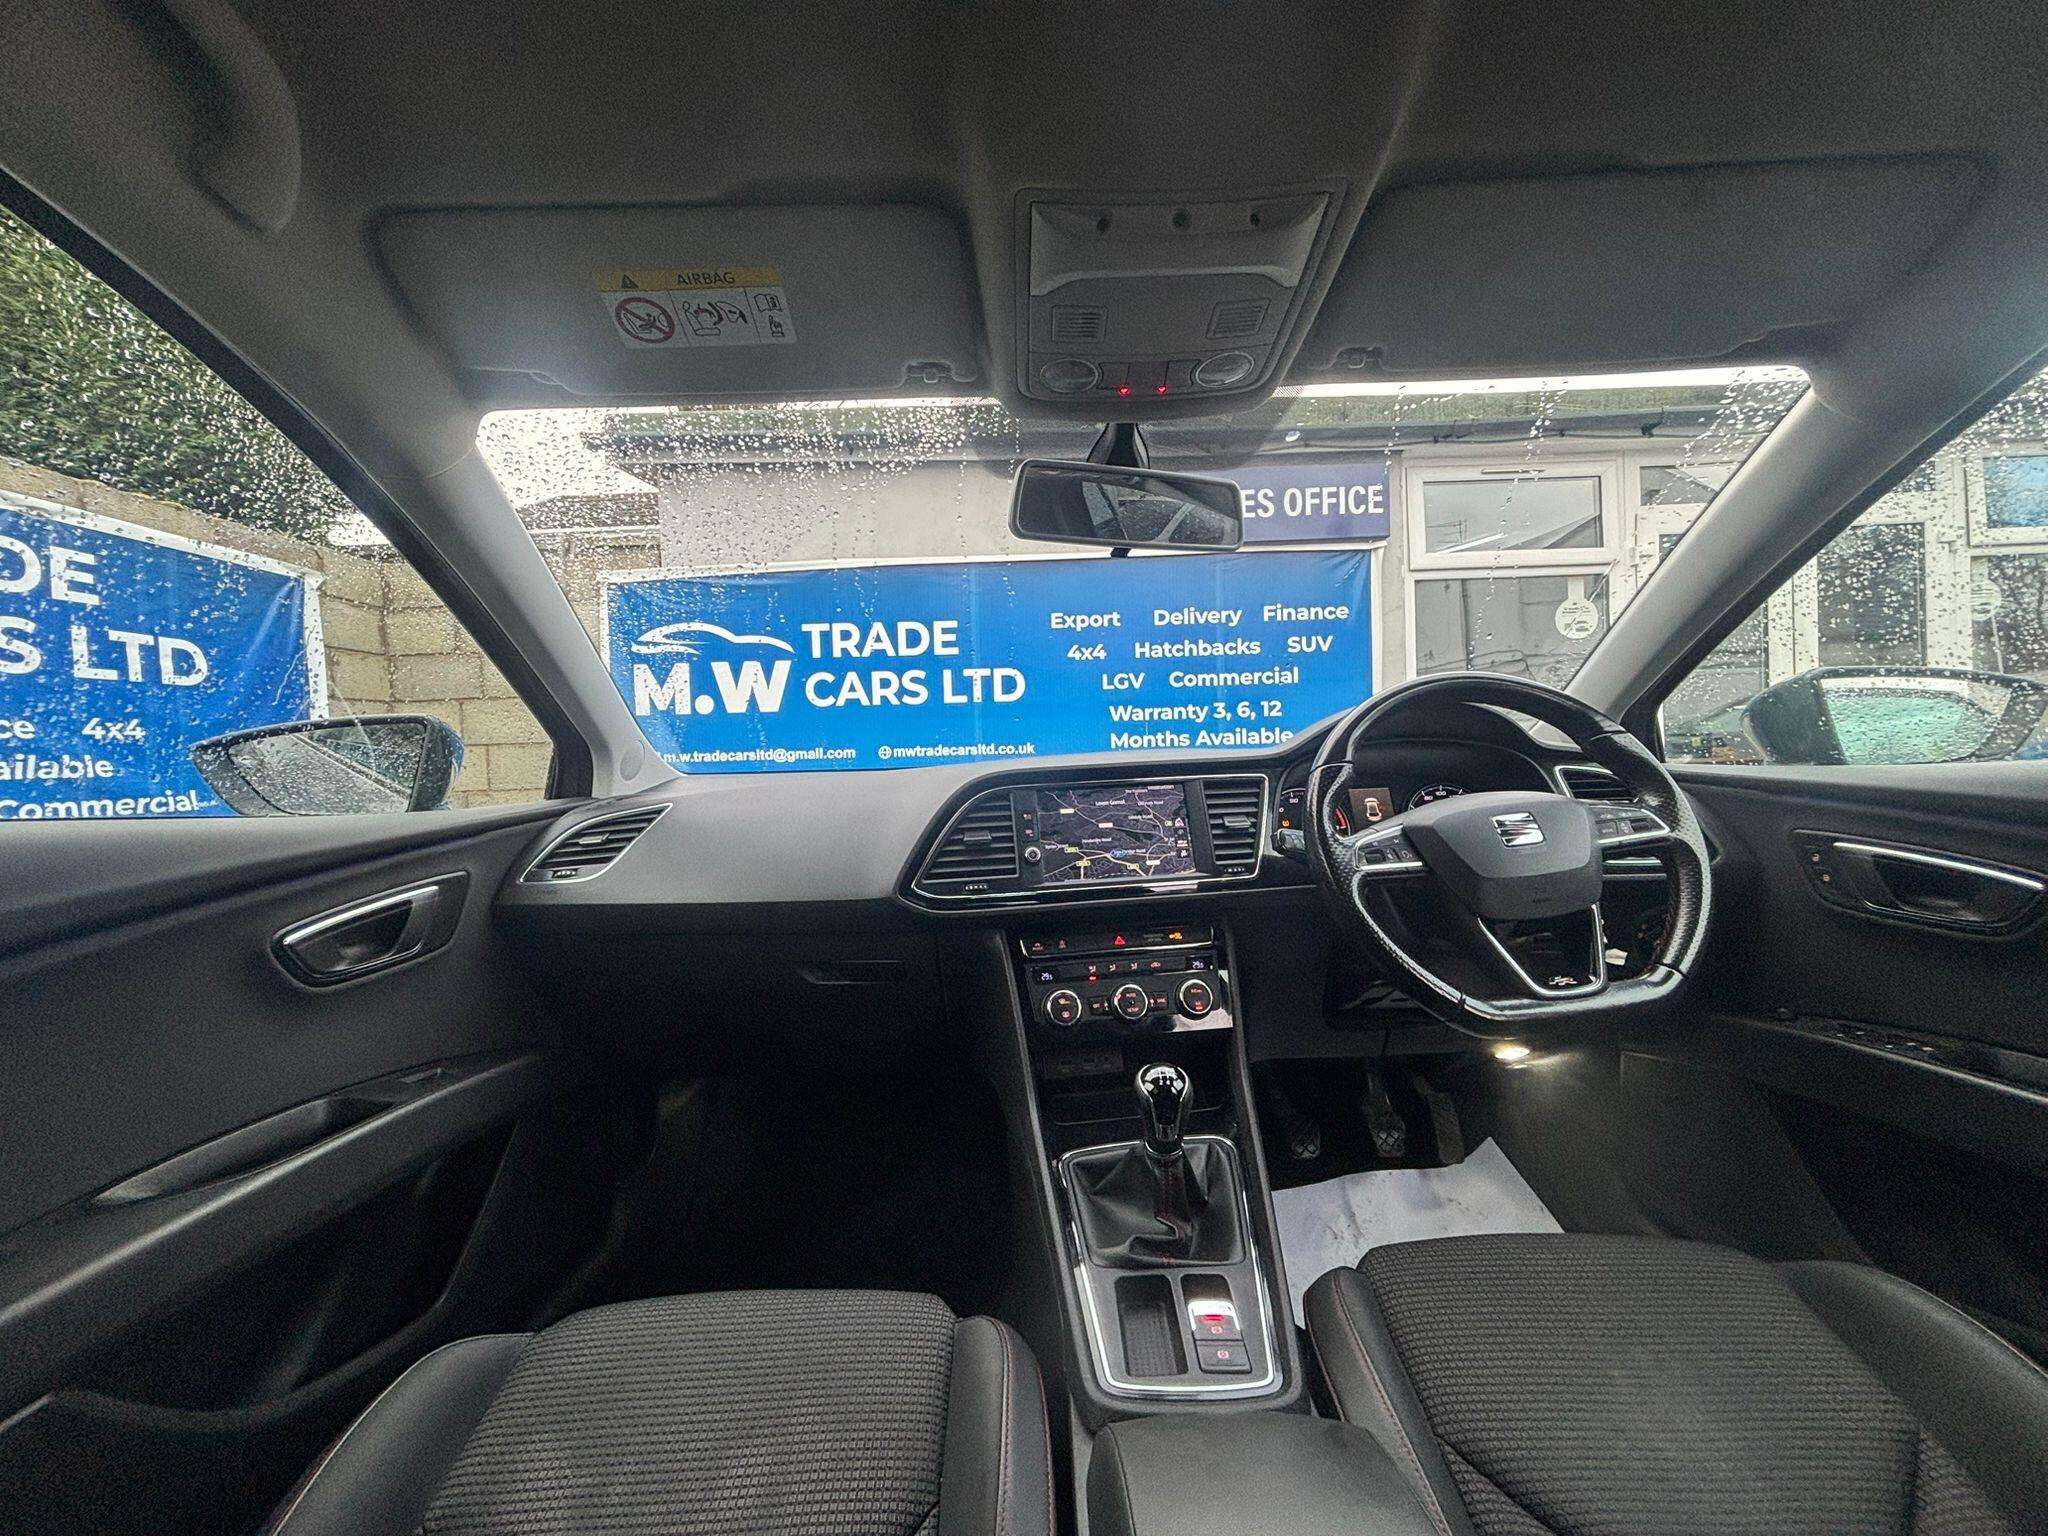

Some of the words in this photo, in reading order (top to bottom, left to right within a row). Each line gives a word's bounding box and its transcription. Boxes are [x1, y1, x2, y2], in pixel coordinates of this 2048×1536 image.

[676, 271, 736, 287] AIRBAG
[1283, 484, 1384, 517] OFFICE
[1050, 611, 1121, 631] Export
[1153, 606, 1242, 628] Delivery
[1262, 603, 1350, 622] Finance
[801, 619, 960, 659] TRADE
[1067, 643, 1107, 661] 4x4
[1134, 638, 1261, 659] Hatchbacks
[1287, 635, 1333, 653] SUV
[71, 624, 208, 687] LTD
[632, 660, 792, 717] M.W
[805, 669, 929, 708] CARS
[943, 667, 1026, 704] LTD
[1101, 672, 1145, 691] LGV
[1169, 666, 1299, 688] Commercial
[1109, 703, 1209, 723] Warranty
[1213, 702, 1232, 721] 3,
[1237, 701, 1256, 720] 6,
[1260, 700, 1283, 717] 12
[81, 717, 147, 741] 4x4
[1110, 731, 1191, 749] Months
[1195, 727, 1295, 747] Available
[893, 742, 1036, 758] mwtradecarsltd.co.uk
[0, 789, 200, 819] Commercial
